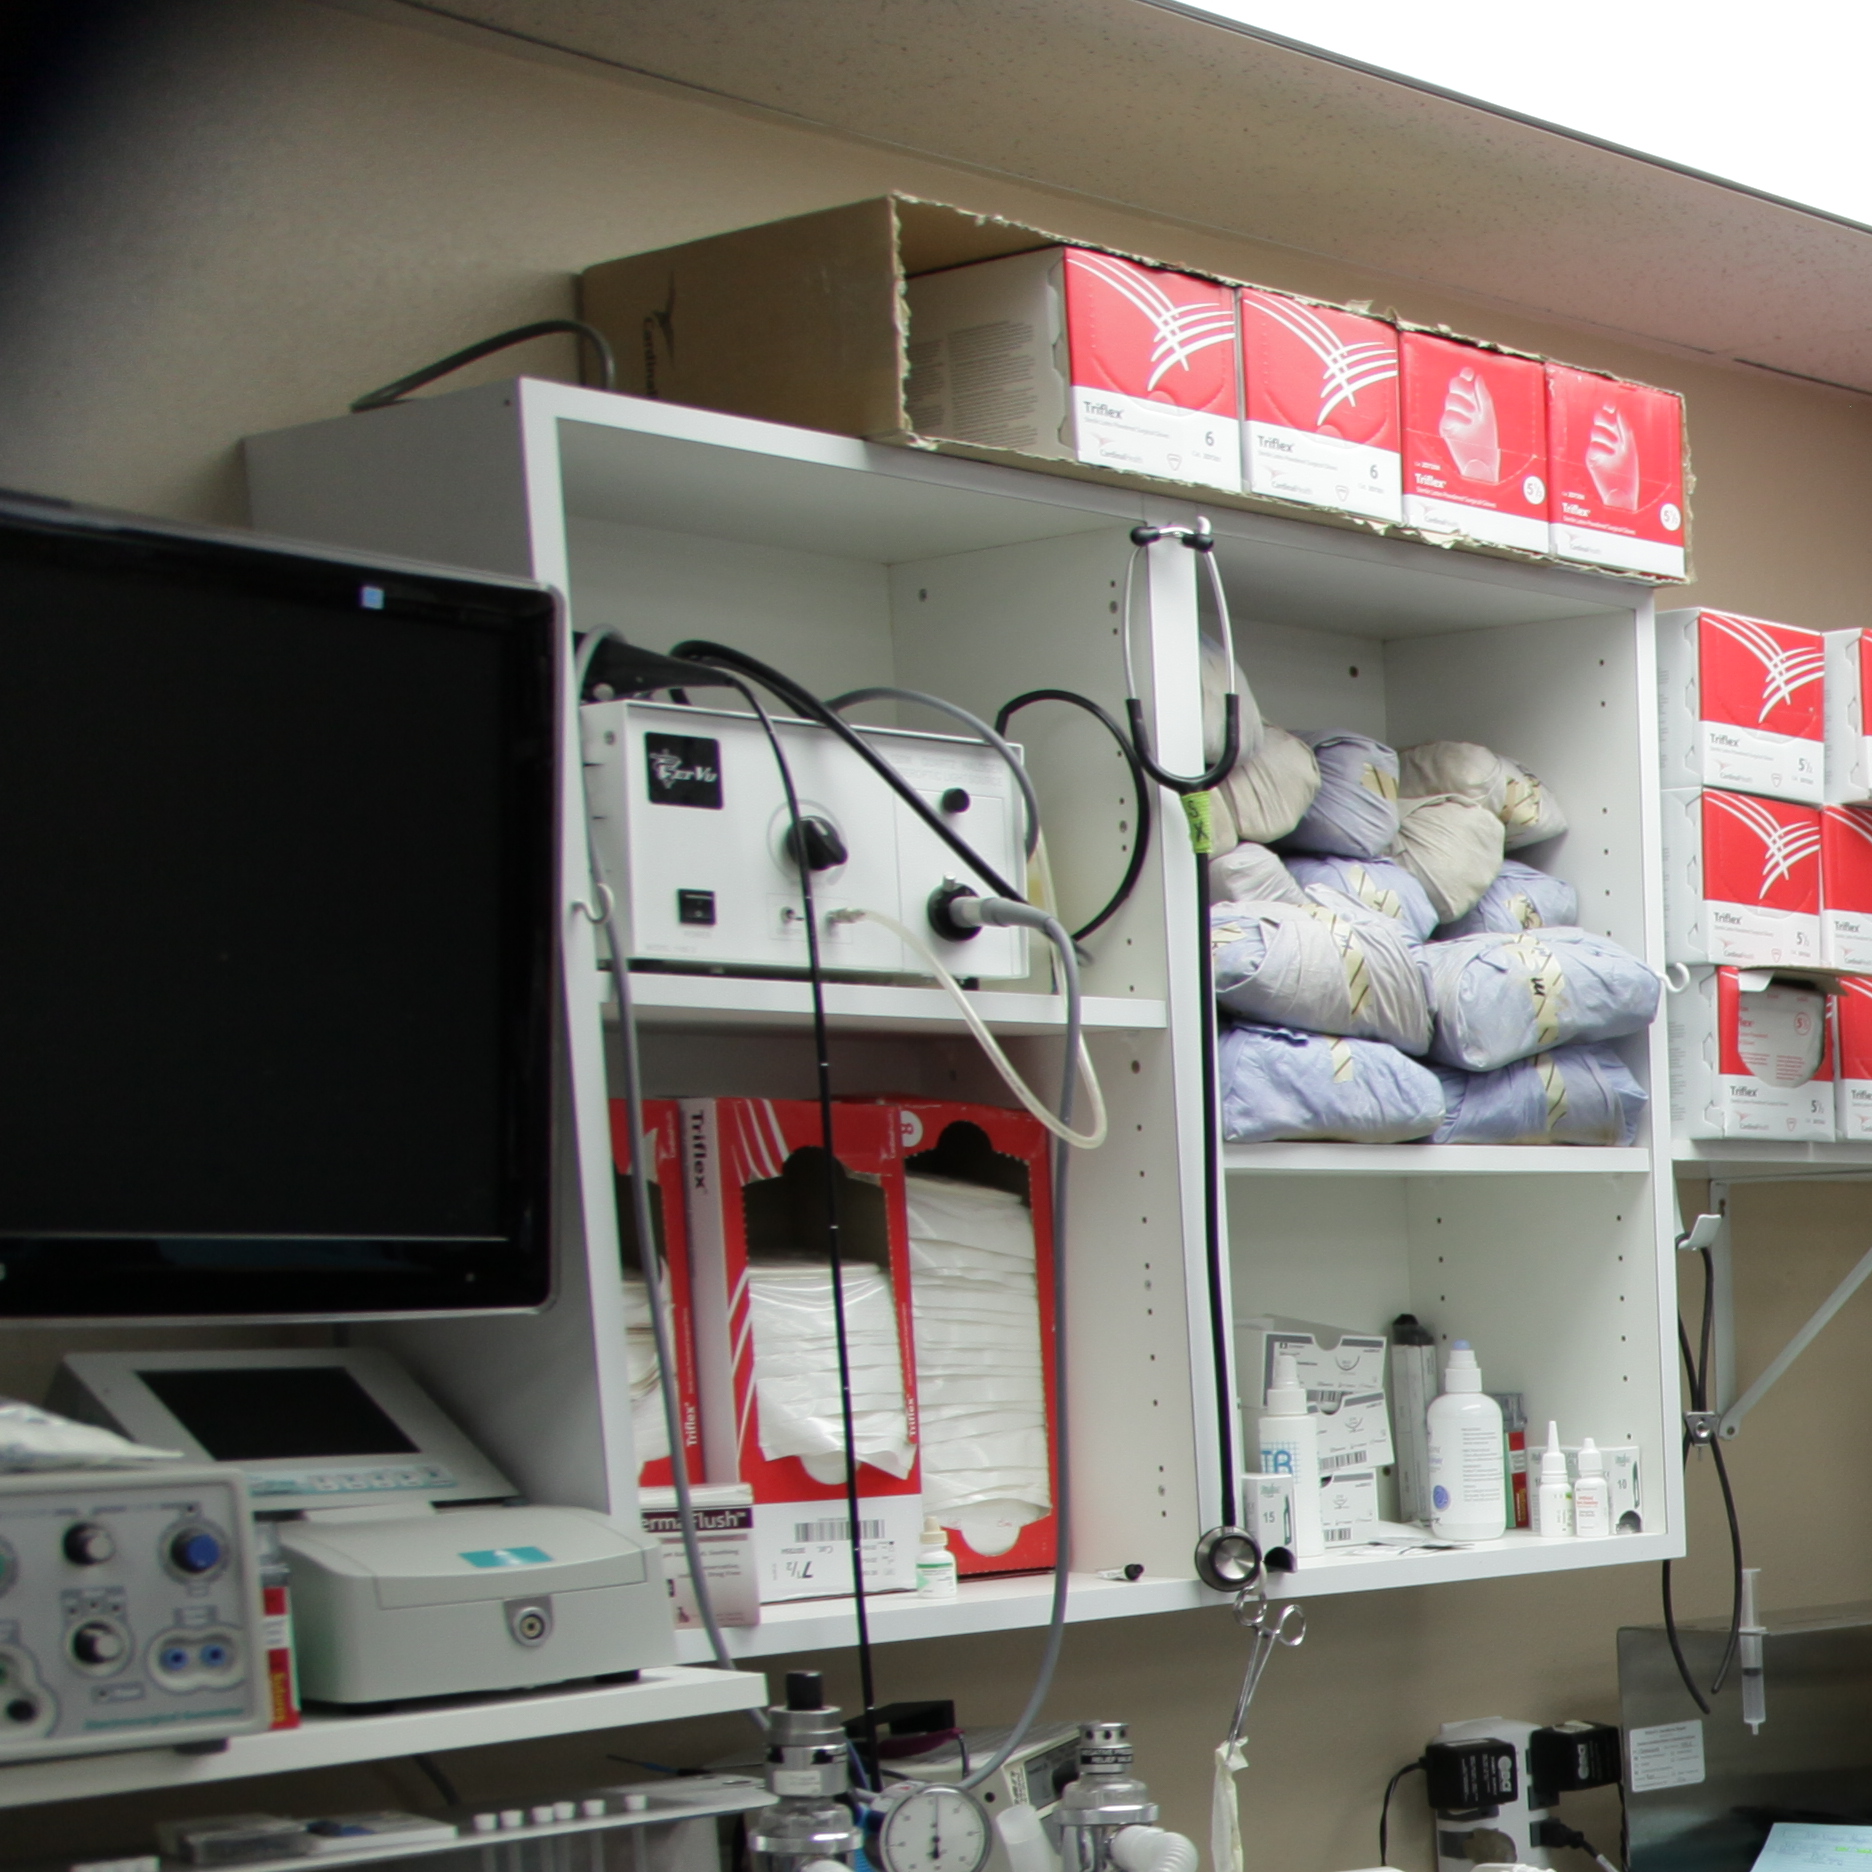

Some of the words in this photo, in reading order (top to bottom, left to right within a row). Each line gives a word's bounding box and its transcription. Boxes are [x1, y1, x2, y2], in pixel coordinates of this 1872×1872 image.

[1083, 401, 1125, 420] Triflex
[1204, 430, 1215, 447] 6
[1257, 434, 1295, 453] Triflex
[1369, 463, 1379, 480] 6
[1414, 473, 1447, 489] Triflex
[1562, 502, 1591, 518] Triflex
[1710, 732, 1740, 748] Triflex
[1714, 911, 1742, 925] Triflex
[1834, 920, 1861, 933] Triflex
[1730, 1085, 1759, 1098] Triflex
[691, 1109, 707, 1190] Triflex
[907, 1393, 916, 1437] Triflex
[686, 1401, 698, 1447] Triflex
[1617, 1478, 1627, 1490] 10
[641, 1516, 682, 1533] erma
[1263, 1511, 1275, 1524] 15
